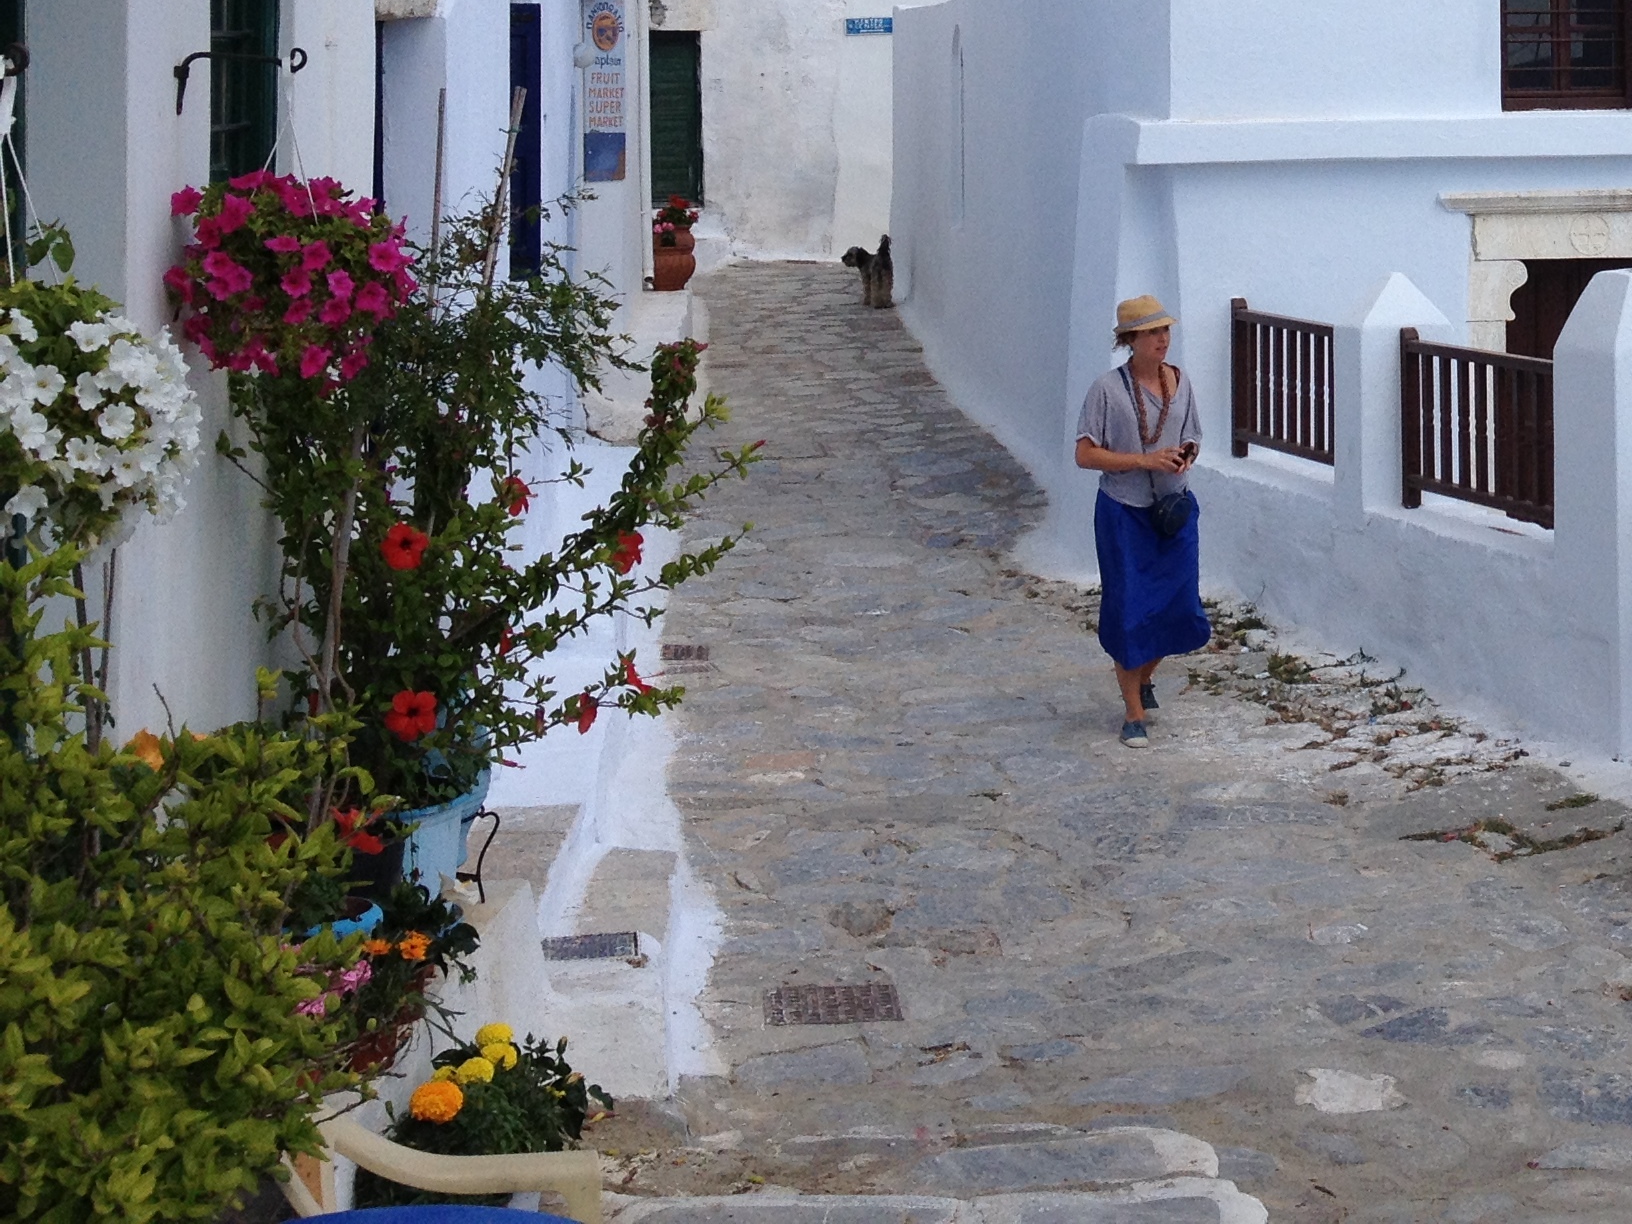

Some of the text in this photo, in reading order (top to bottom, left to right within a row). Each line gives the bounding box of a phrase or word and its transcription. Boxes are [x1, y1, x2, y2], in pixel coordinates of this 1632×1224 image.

[591, 72, 620, 84] FRUIT
[588, 87, 624, 98] MARKET
[589, 100, 621, 113] SUPER
[588, 116, 623, 128] MARKET
